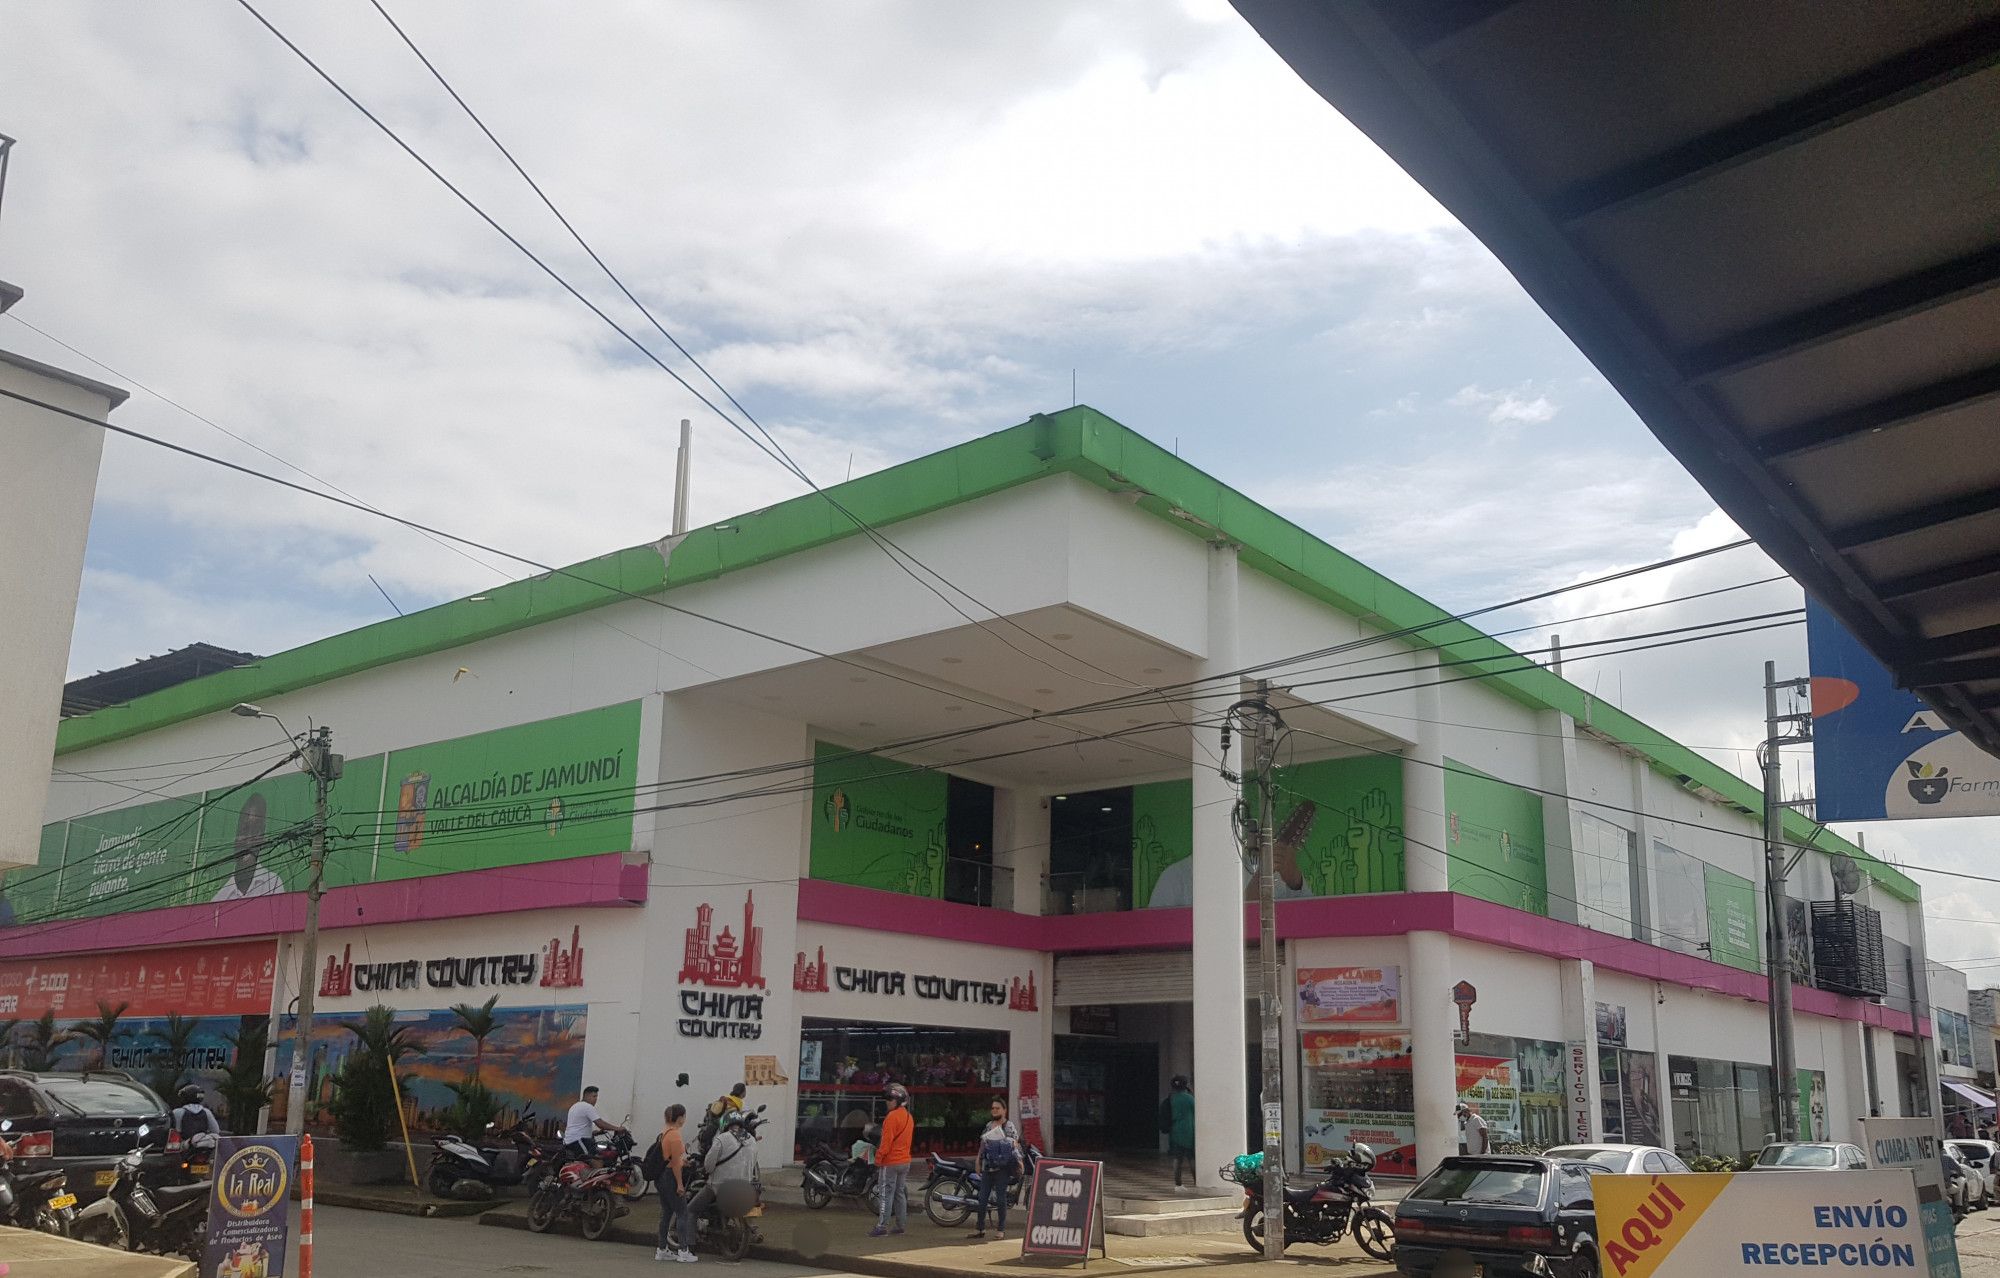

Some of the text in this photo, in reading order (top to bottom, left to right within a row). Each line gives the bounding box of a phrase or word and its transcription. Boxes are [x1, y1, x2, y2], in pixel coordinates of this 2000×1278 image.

[433, 748, 623, 809] ALCALDÍA DE JAMUNDÍ
[430, 804, 532, 835] VALLE DEL CAUCA
[856, 813, 914, 839] Ciudadanos
[122, 849, 135, 870] de
[135, 847, 168, 875] gente
[354, 953, 538, 991] CHINA COUNTRY
[835, 966, 1007, 1006] CHINA COUNTRY
[680, 990, 764, 1020] CHINA
[678, 1019, 762, 1040] COUNTRY
[1573, 1048, 1585, 1103] SERVICIO
[1875, 1136, 1935, 1164] CUMBA NET
[230, 1172, 275, 1199] La Real
[1046, 1178, 1082, 1198] CALDO
[227, 1219, 269, 1228] Distribuidora
[1052, 1202, 1069, 1221] DE
[1813, 1199, 1907, 1228] ENVÍO
[209, 1233, 282, 1245] de Productos de Aseo
[223, 1226, 279, 1236] Comercializadora
[1031, 1225, 1082, 1247] COSTILLA
[1604, 1175, 1686, 1277] AQUÍ
[1741, 1237, 1915, 1268] RECEPCIÓN
